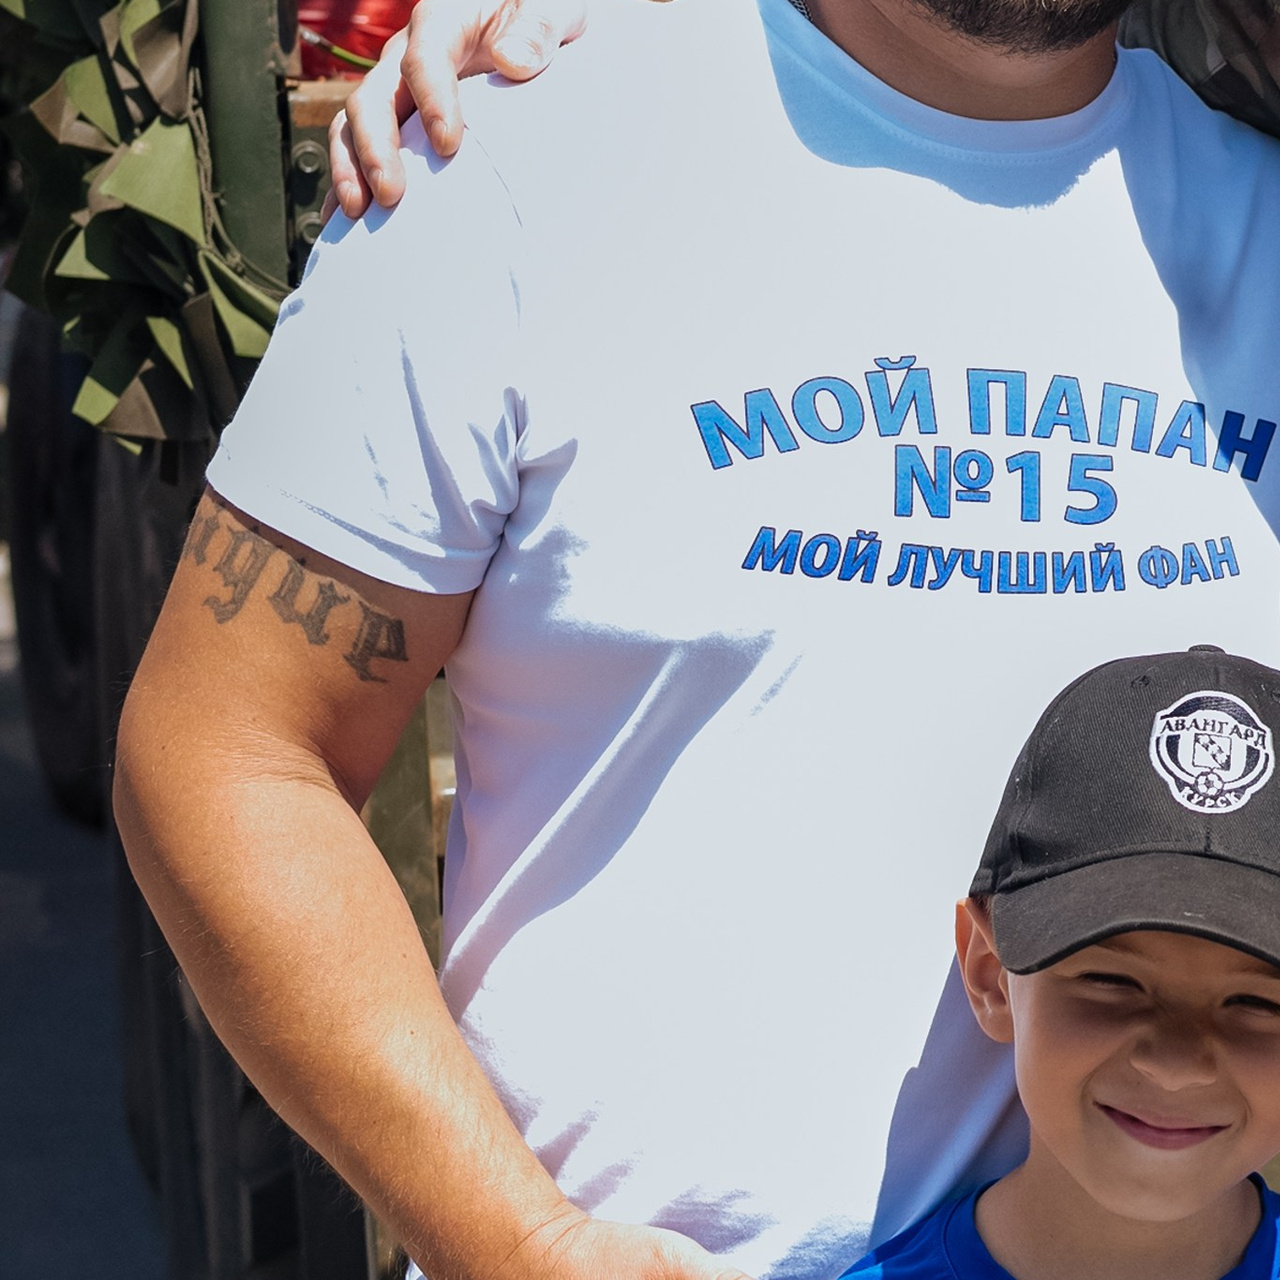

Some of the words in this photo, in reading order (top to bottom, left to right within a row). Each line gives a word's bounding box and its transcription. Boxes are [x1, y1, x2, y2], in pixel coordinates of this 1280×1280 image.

[690, 354, 938, 470] МОЙ
[965, 367, 1276, 483] ПАПАН
[893, 444, 1119, 526] №15
[741, 526, 882, 584] МОЙ
[887, 542, 1126, 594] ЛУЧШИЙ
[1138, 536, 1241, 590] ФАН
[1161, 718, 1267, 750] АВАНГАРД
[1181, 786, 1242, 808] КУРСК
